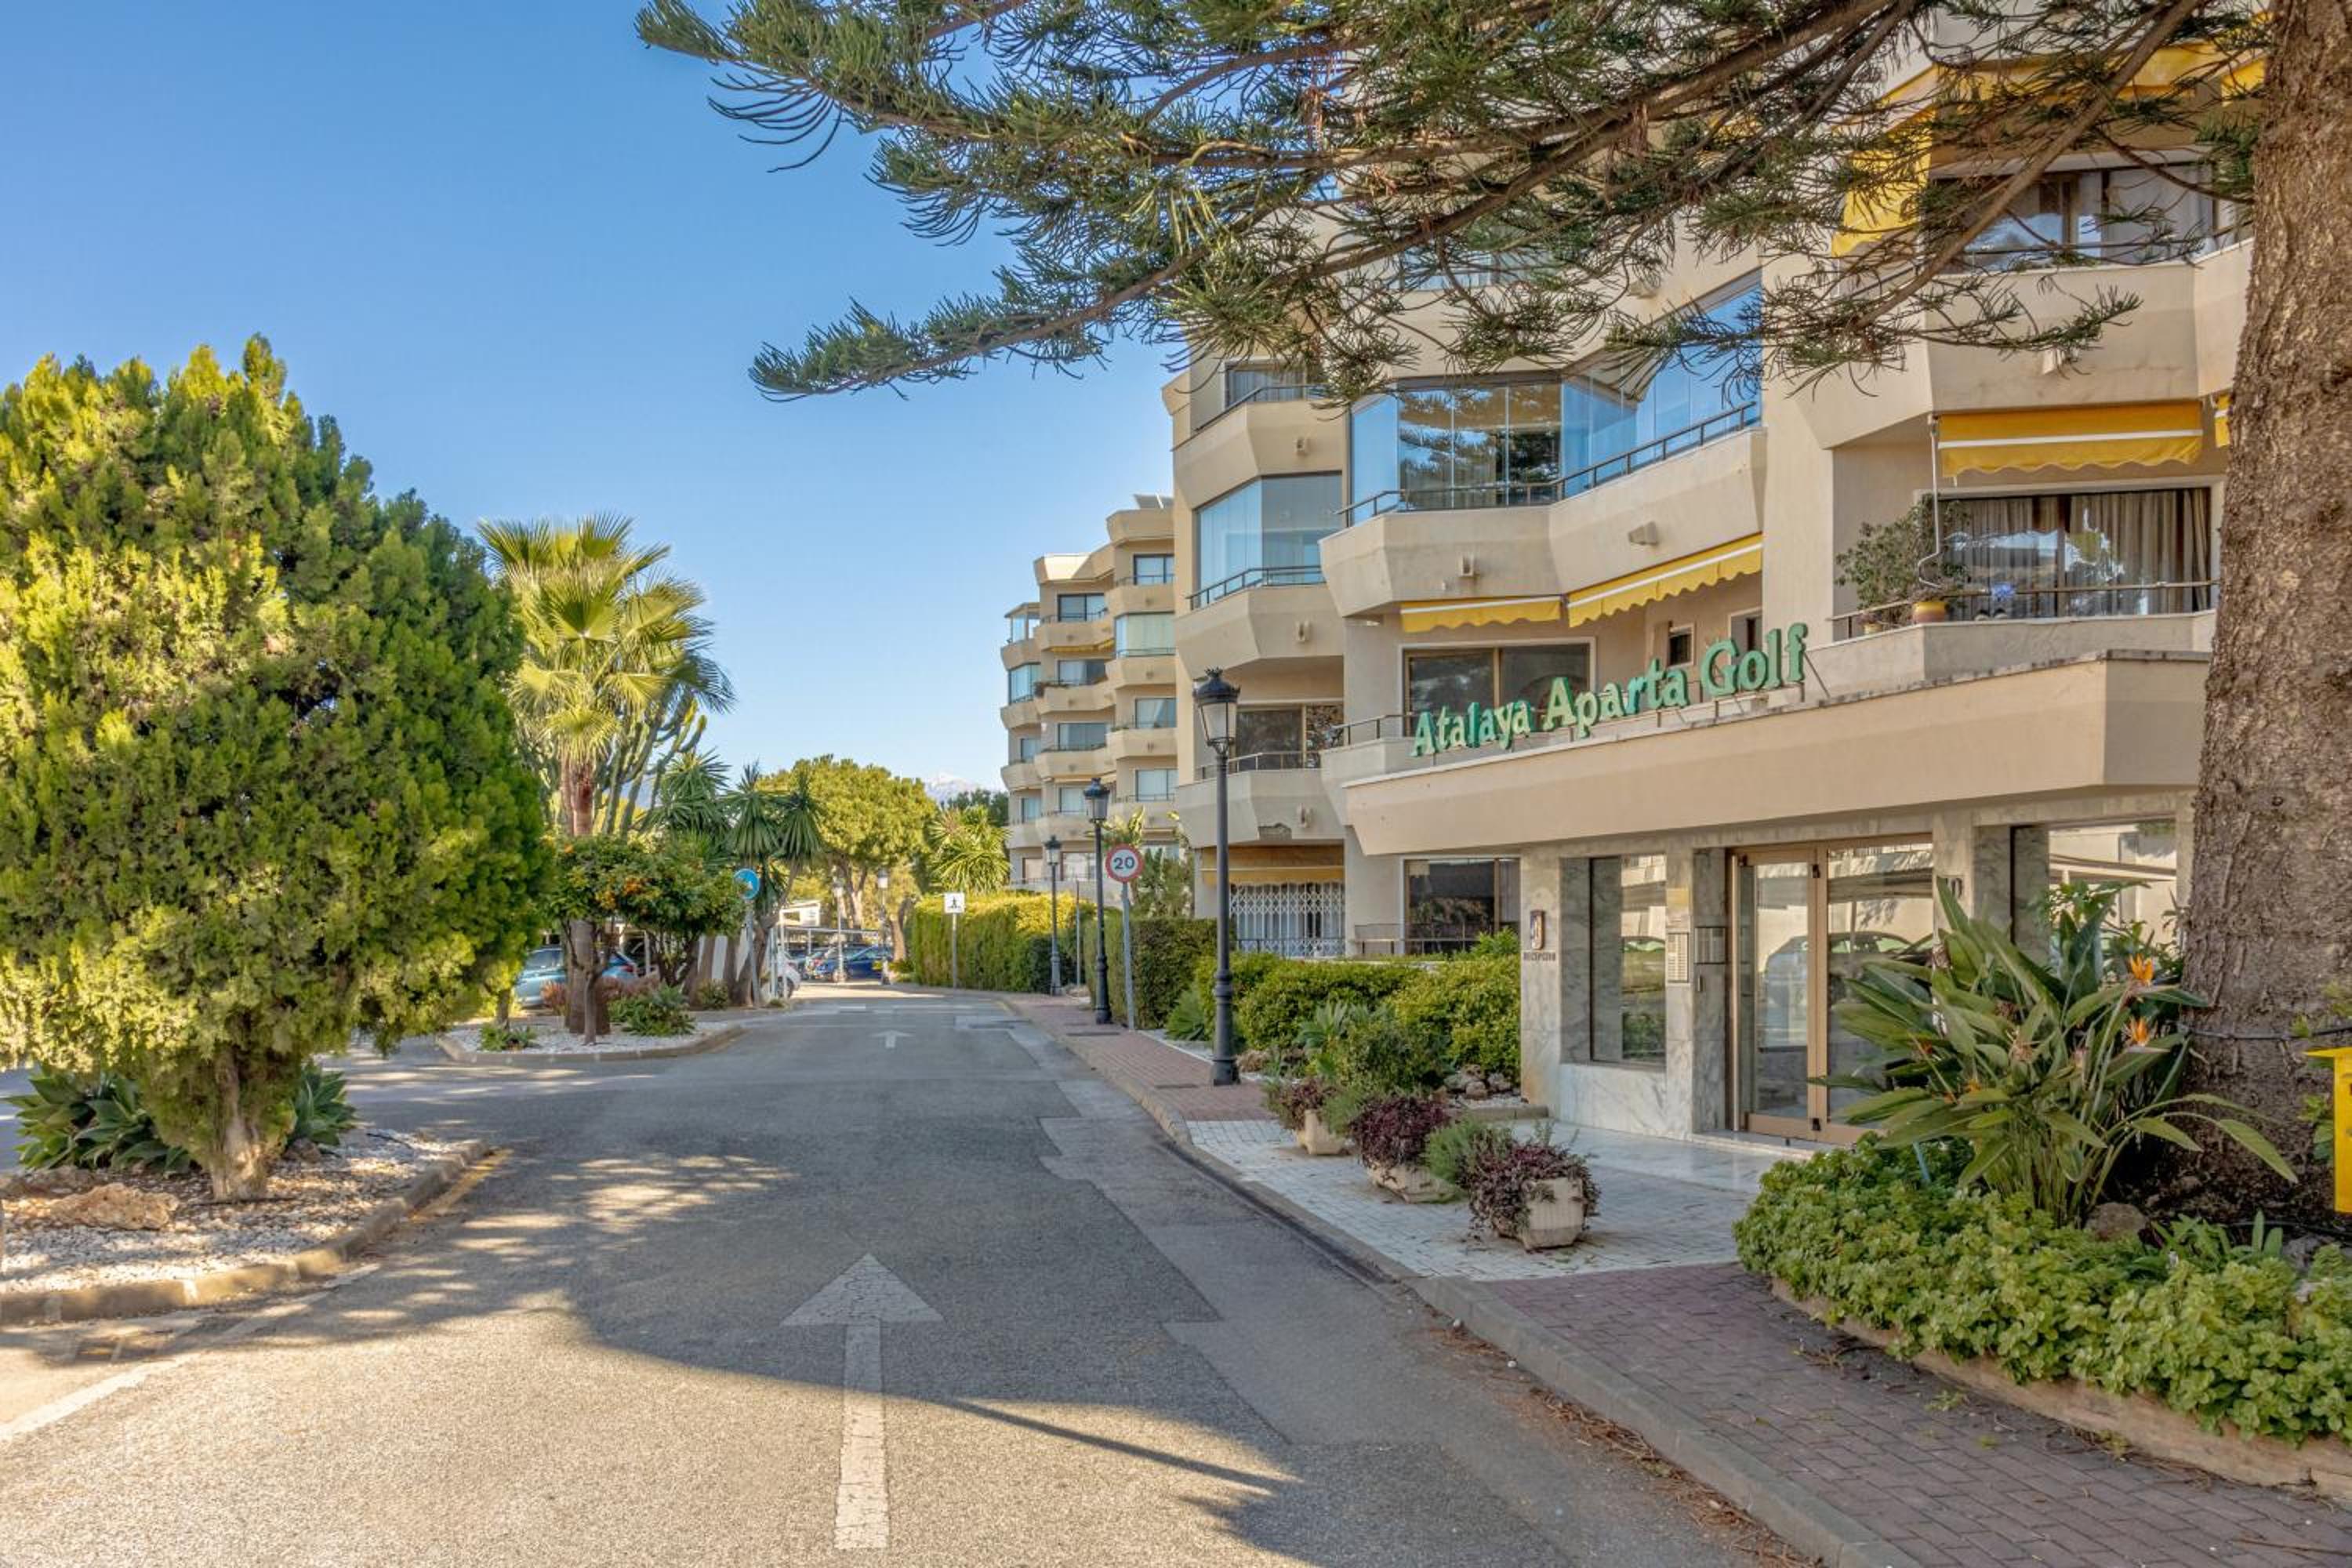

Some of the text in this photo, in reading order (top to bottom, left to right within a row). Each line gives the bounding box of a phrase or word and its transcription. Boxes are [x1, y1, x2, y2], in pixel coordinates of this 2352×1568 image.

[1410, 622, 1809, 757] Atalaya Aparta Golf
[1113, 856, 1135, 870] 20
